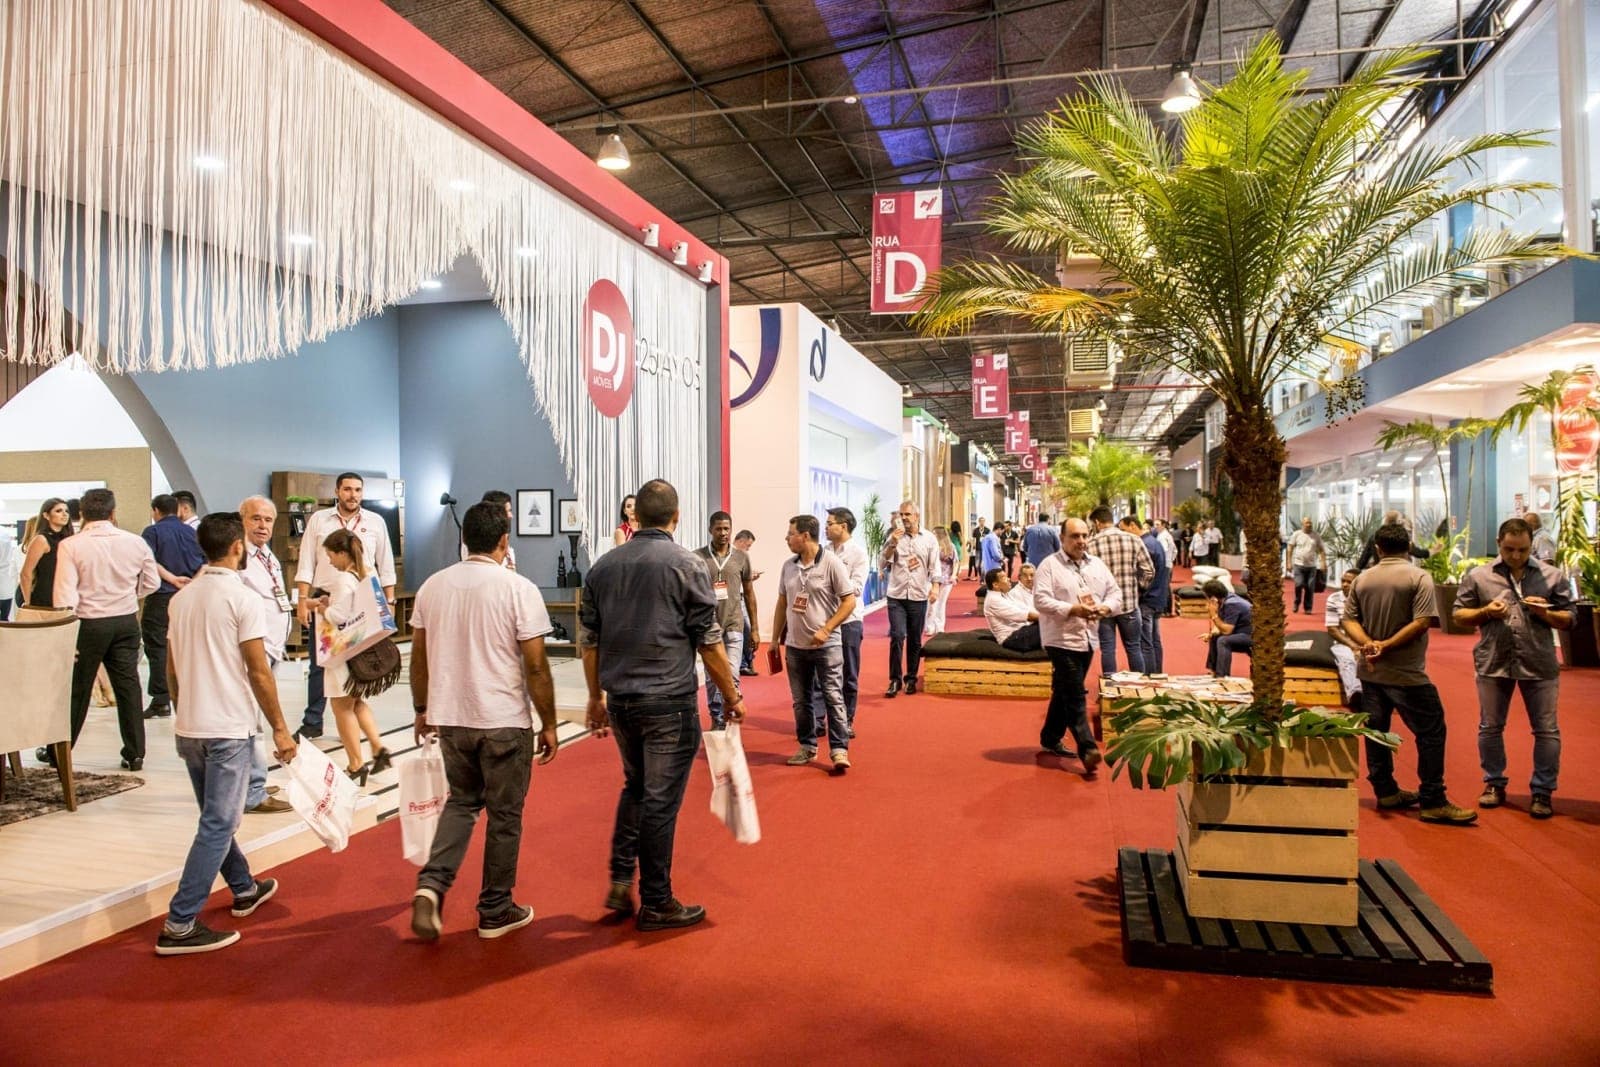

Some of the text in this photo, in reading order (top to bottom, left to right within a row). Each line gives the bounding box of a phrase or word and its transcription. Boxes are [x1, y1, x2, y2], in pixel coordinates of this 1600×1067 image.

[875, 235, 900, 248] RUA
[885, 251, 927, 304] D
[592, 309, 626, 392] DJ
[980, 386, 998, 413] E
[1011, 432, 1023, 451] F
[1022, 454, 1034, 470] G
[1035, 469, 1046, 481] H
